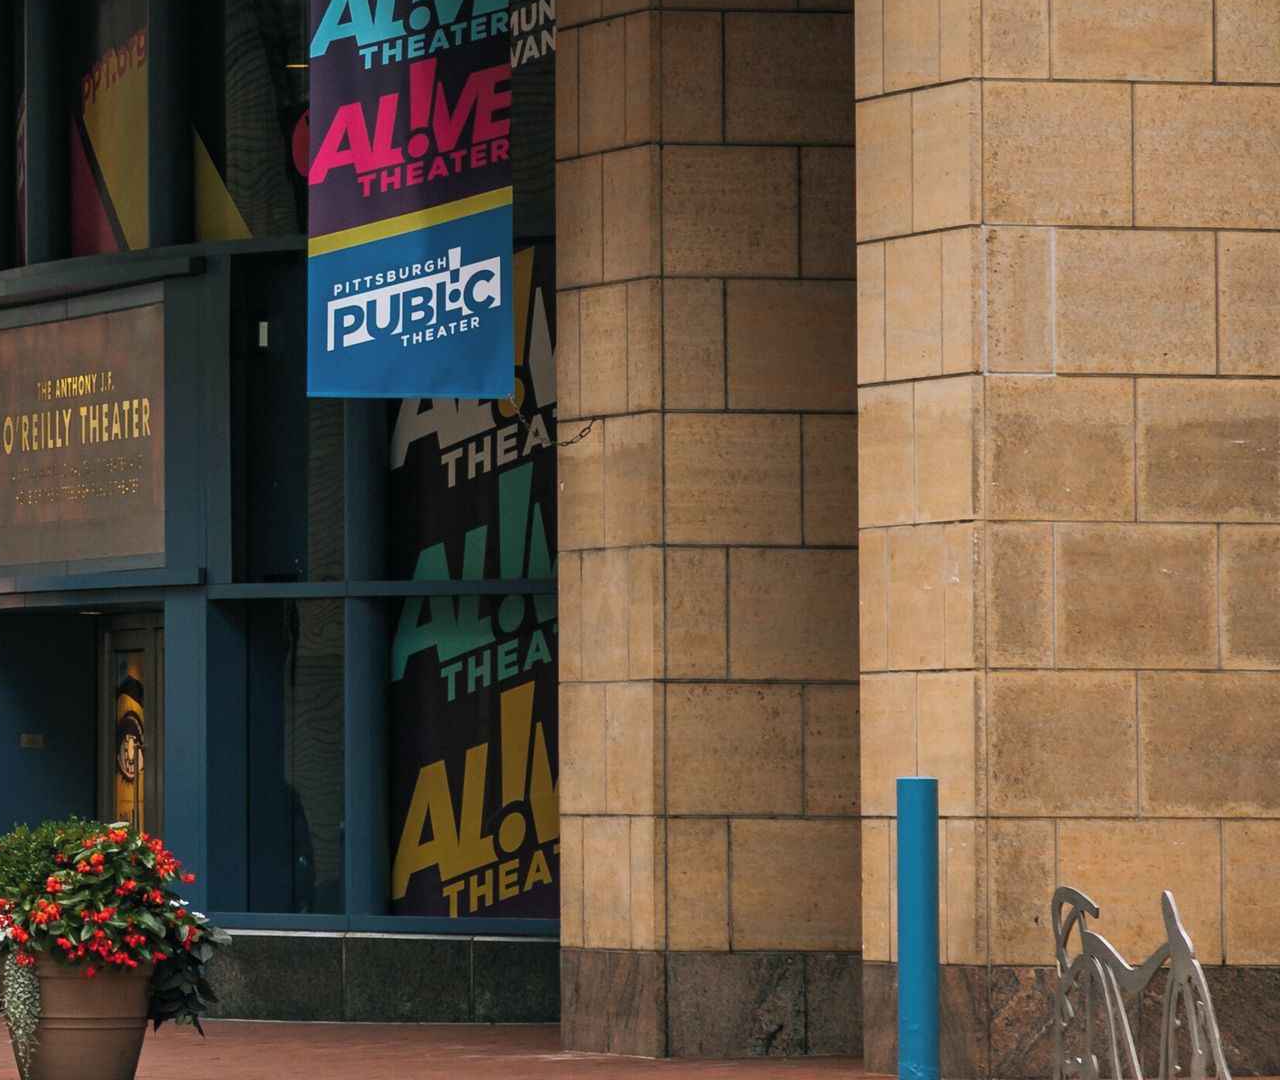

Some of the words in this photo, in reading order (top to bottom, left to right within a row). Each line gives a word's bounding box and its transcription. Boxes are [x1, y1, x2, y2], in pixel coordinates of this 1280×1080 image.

[359, 10, 510, 70] THEATER
[358, 138, 510, 197] THEATER
[333, 256, 447, 297] PITTSBURGH
[401, 316, 481, 347] THEATER
[37, 380, 52, 400] THE
[55, 374, 97, 399] ANTHONY
[2, 408, 72, 455] O'REILLY
[80, 397, 151, 445] THEATER
[441, 410, 557, 488] THEA
[441, 624, 558, 702] THEA
[443, 844, 559, 919] THEA
